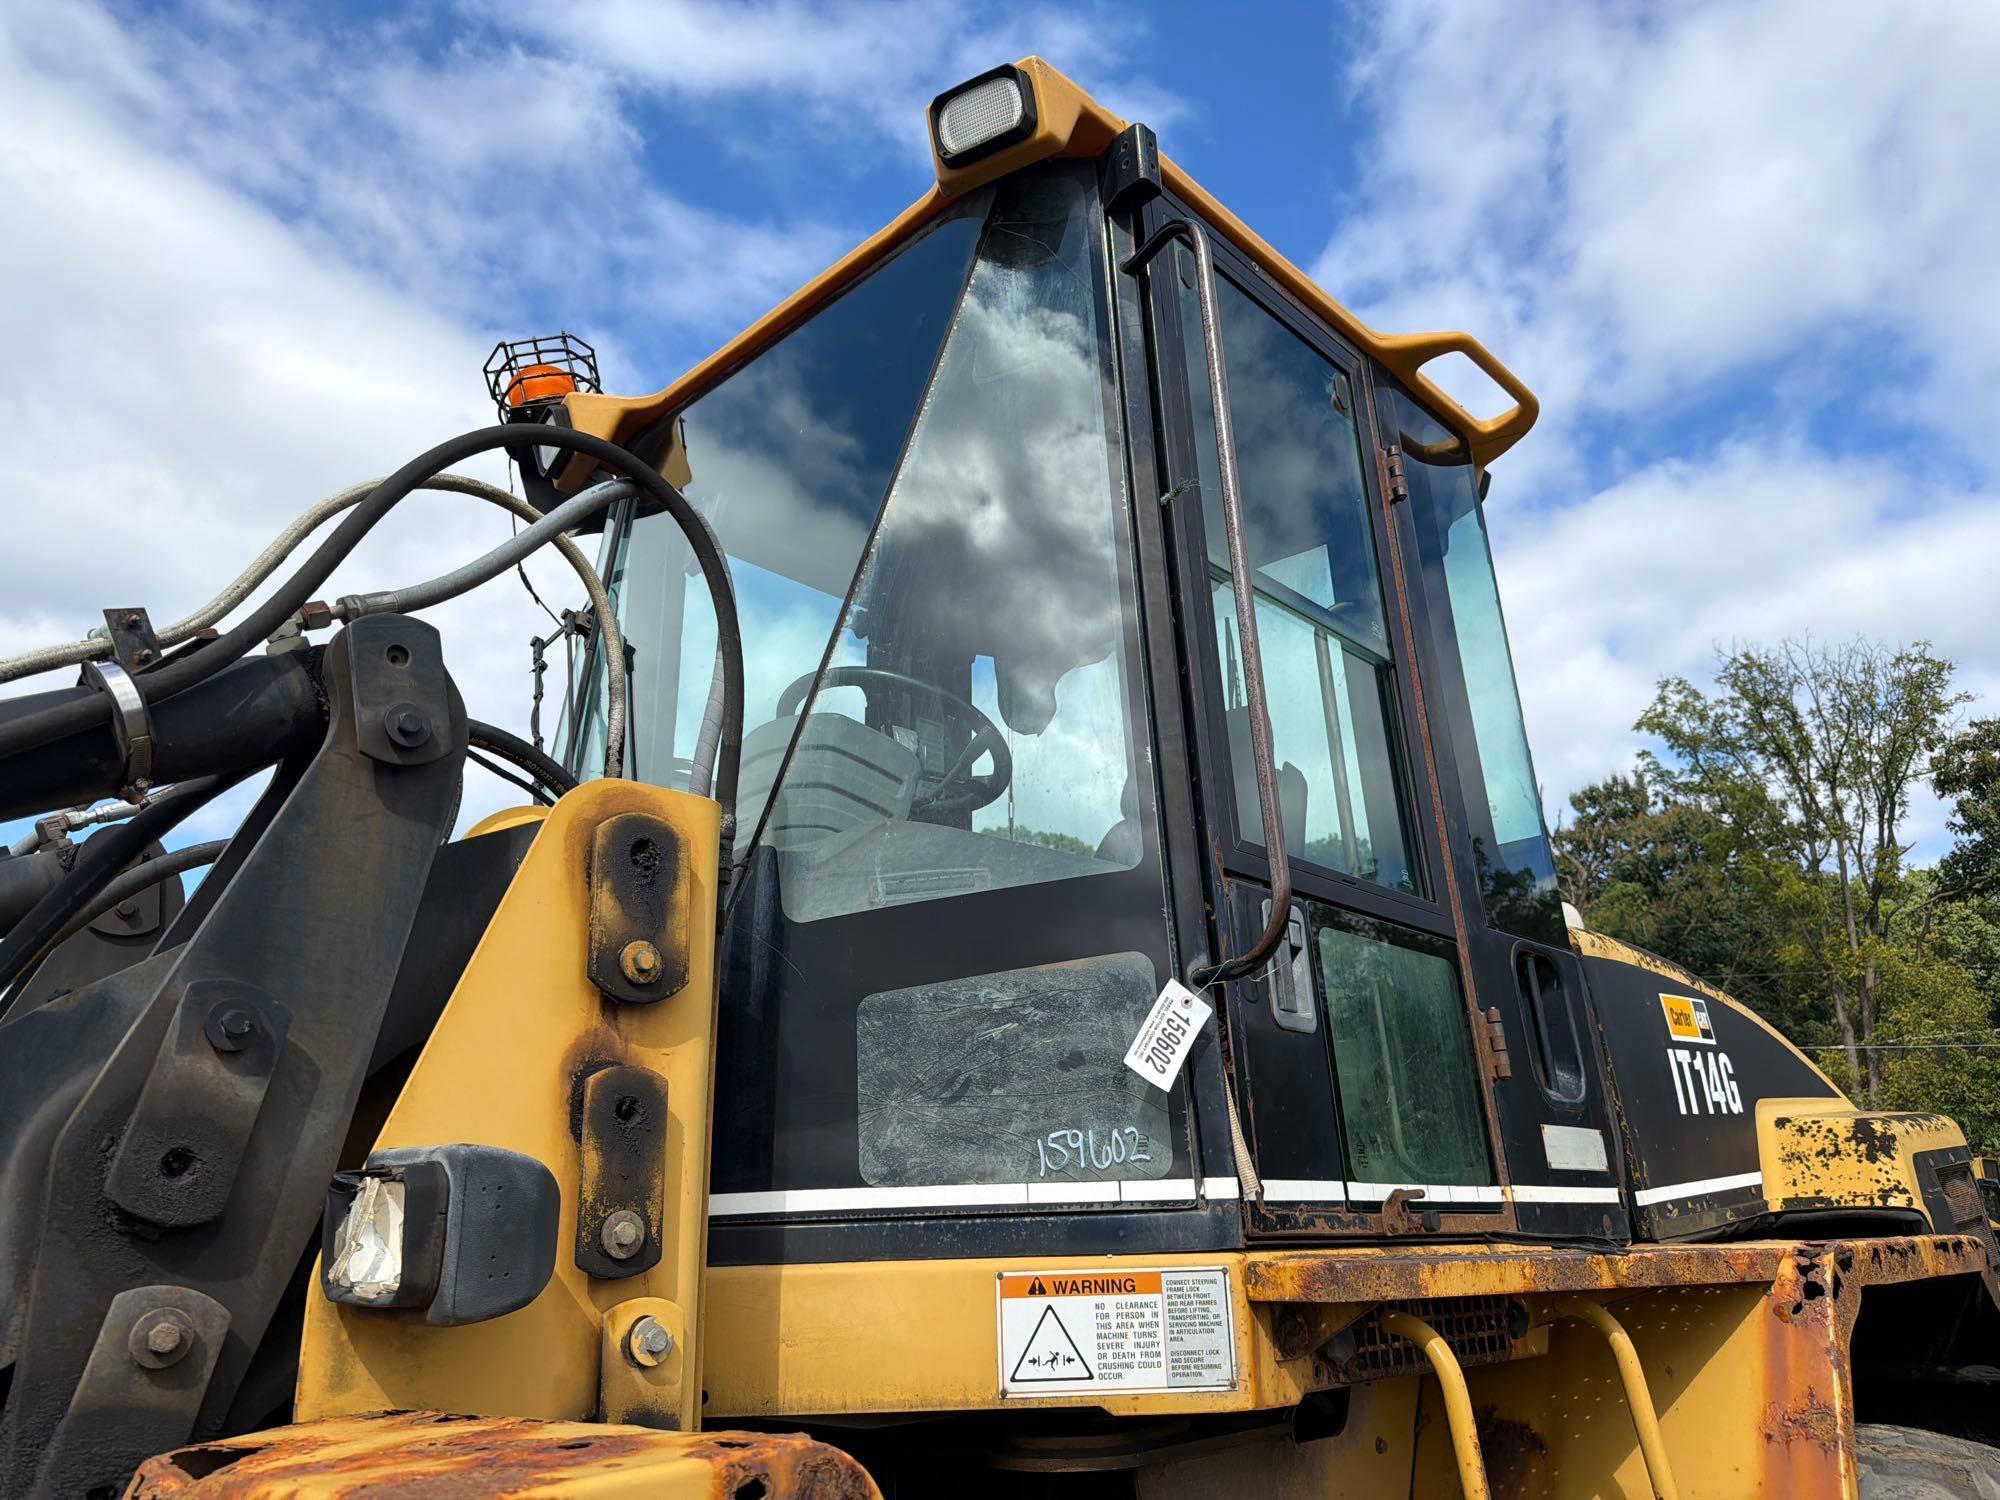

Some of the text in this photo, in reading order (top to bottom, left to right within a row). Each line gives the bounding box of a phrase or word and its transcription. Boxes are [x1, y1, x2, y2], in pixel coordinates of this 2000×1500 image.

[1670, 1007, 1692, 1027] Carter
[1145, 1010, 1191, 1074] 159602
[1666, 1049, 1743, 1115] IT14G
[1037, 1126, 1151, 1177] 159602
[1052, 1279, 1136, 1295] WARNING
[1116, 1301, 1158, 1310] CLEARANCE
[1096, 1322, 1112, 1330] THIS
[1138, 1321, 1159, 1329] WHEN
[1097, 1332, 1128, 1340] MACHINE
[1097, 1341, 1160, 1350] SEVERE INJURY
[1098, 1361, 1162, 1370] CRUSHING COULD
